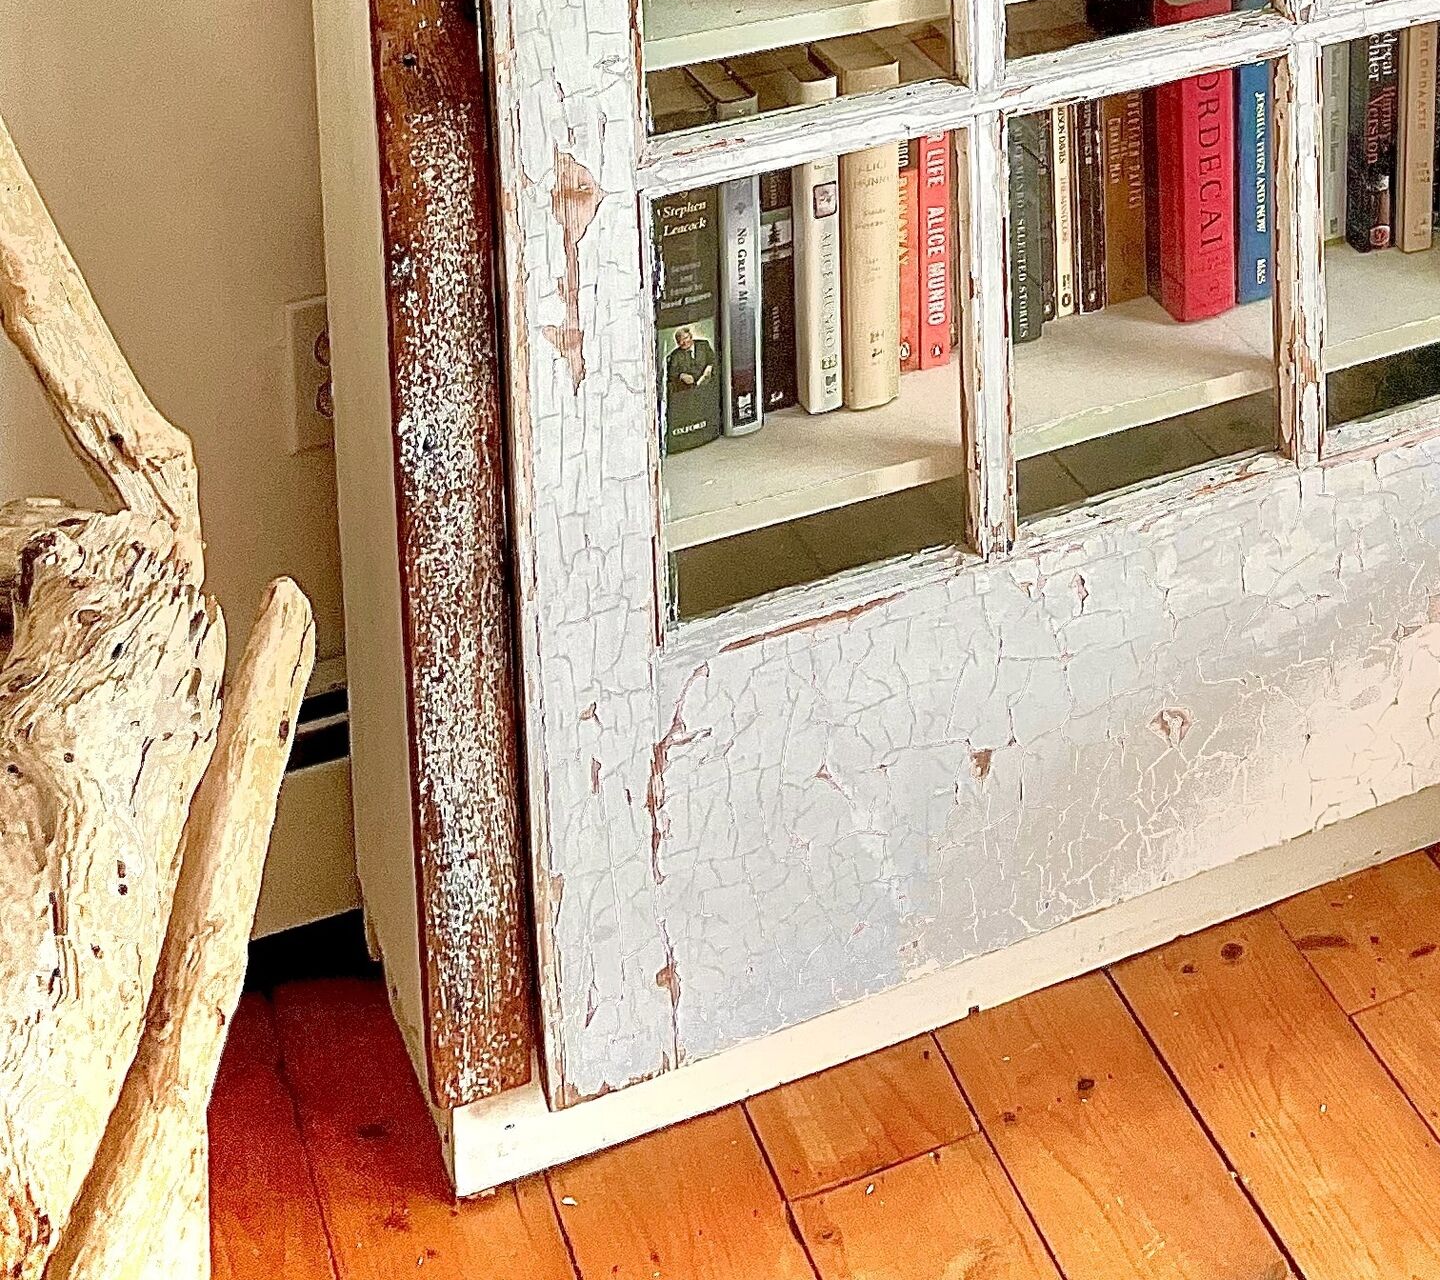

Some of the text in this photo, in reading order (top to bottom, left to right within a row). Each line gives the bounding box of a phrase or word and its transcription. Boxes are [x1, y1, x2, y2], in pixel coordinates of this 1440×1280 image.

[1196, 73, 1223, 249] ORDECAI
[1254, 91, 1268, 234] JOSHUA THEN AND NOW
[1366, 98, 1384, 165] Version
[661, 200, 707, 220] Stephen
[662, 217, 707, 238] Leacock
[926, 148, 947, 326] LIFE ALICE MUNRO
[737, 249, 749, 287] GREAT
[1016, 218, 1030, 338] SELECTED STORIES
[672, 420, 707, 437] OXFORD
